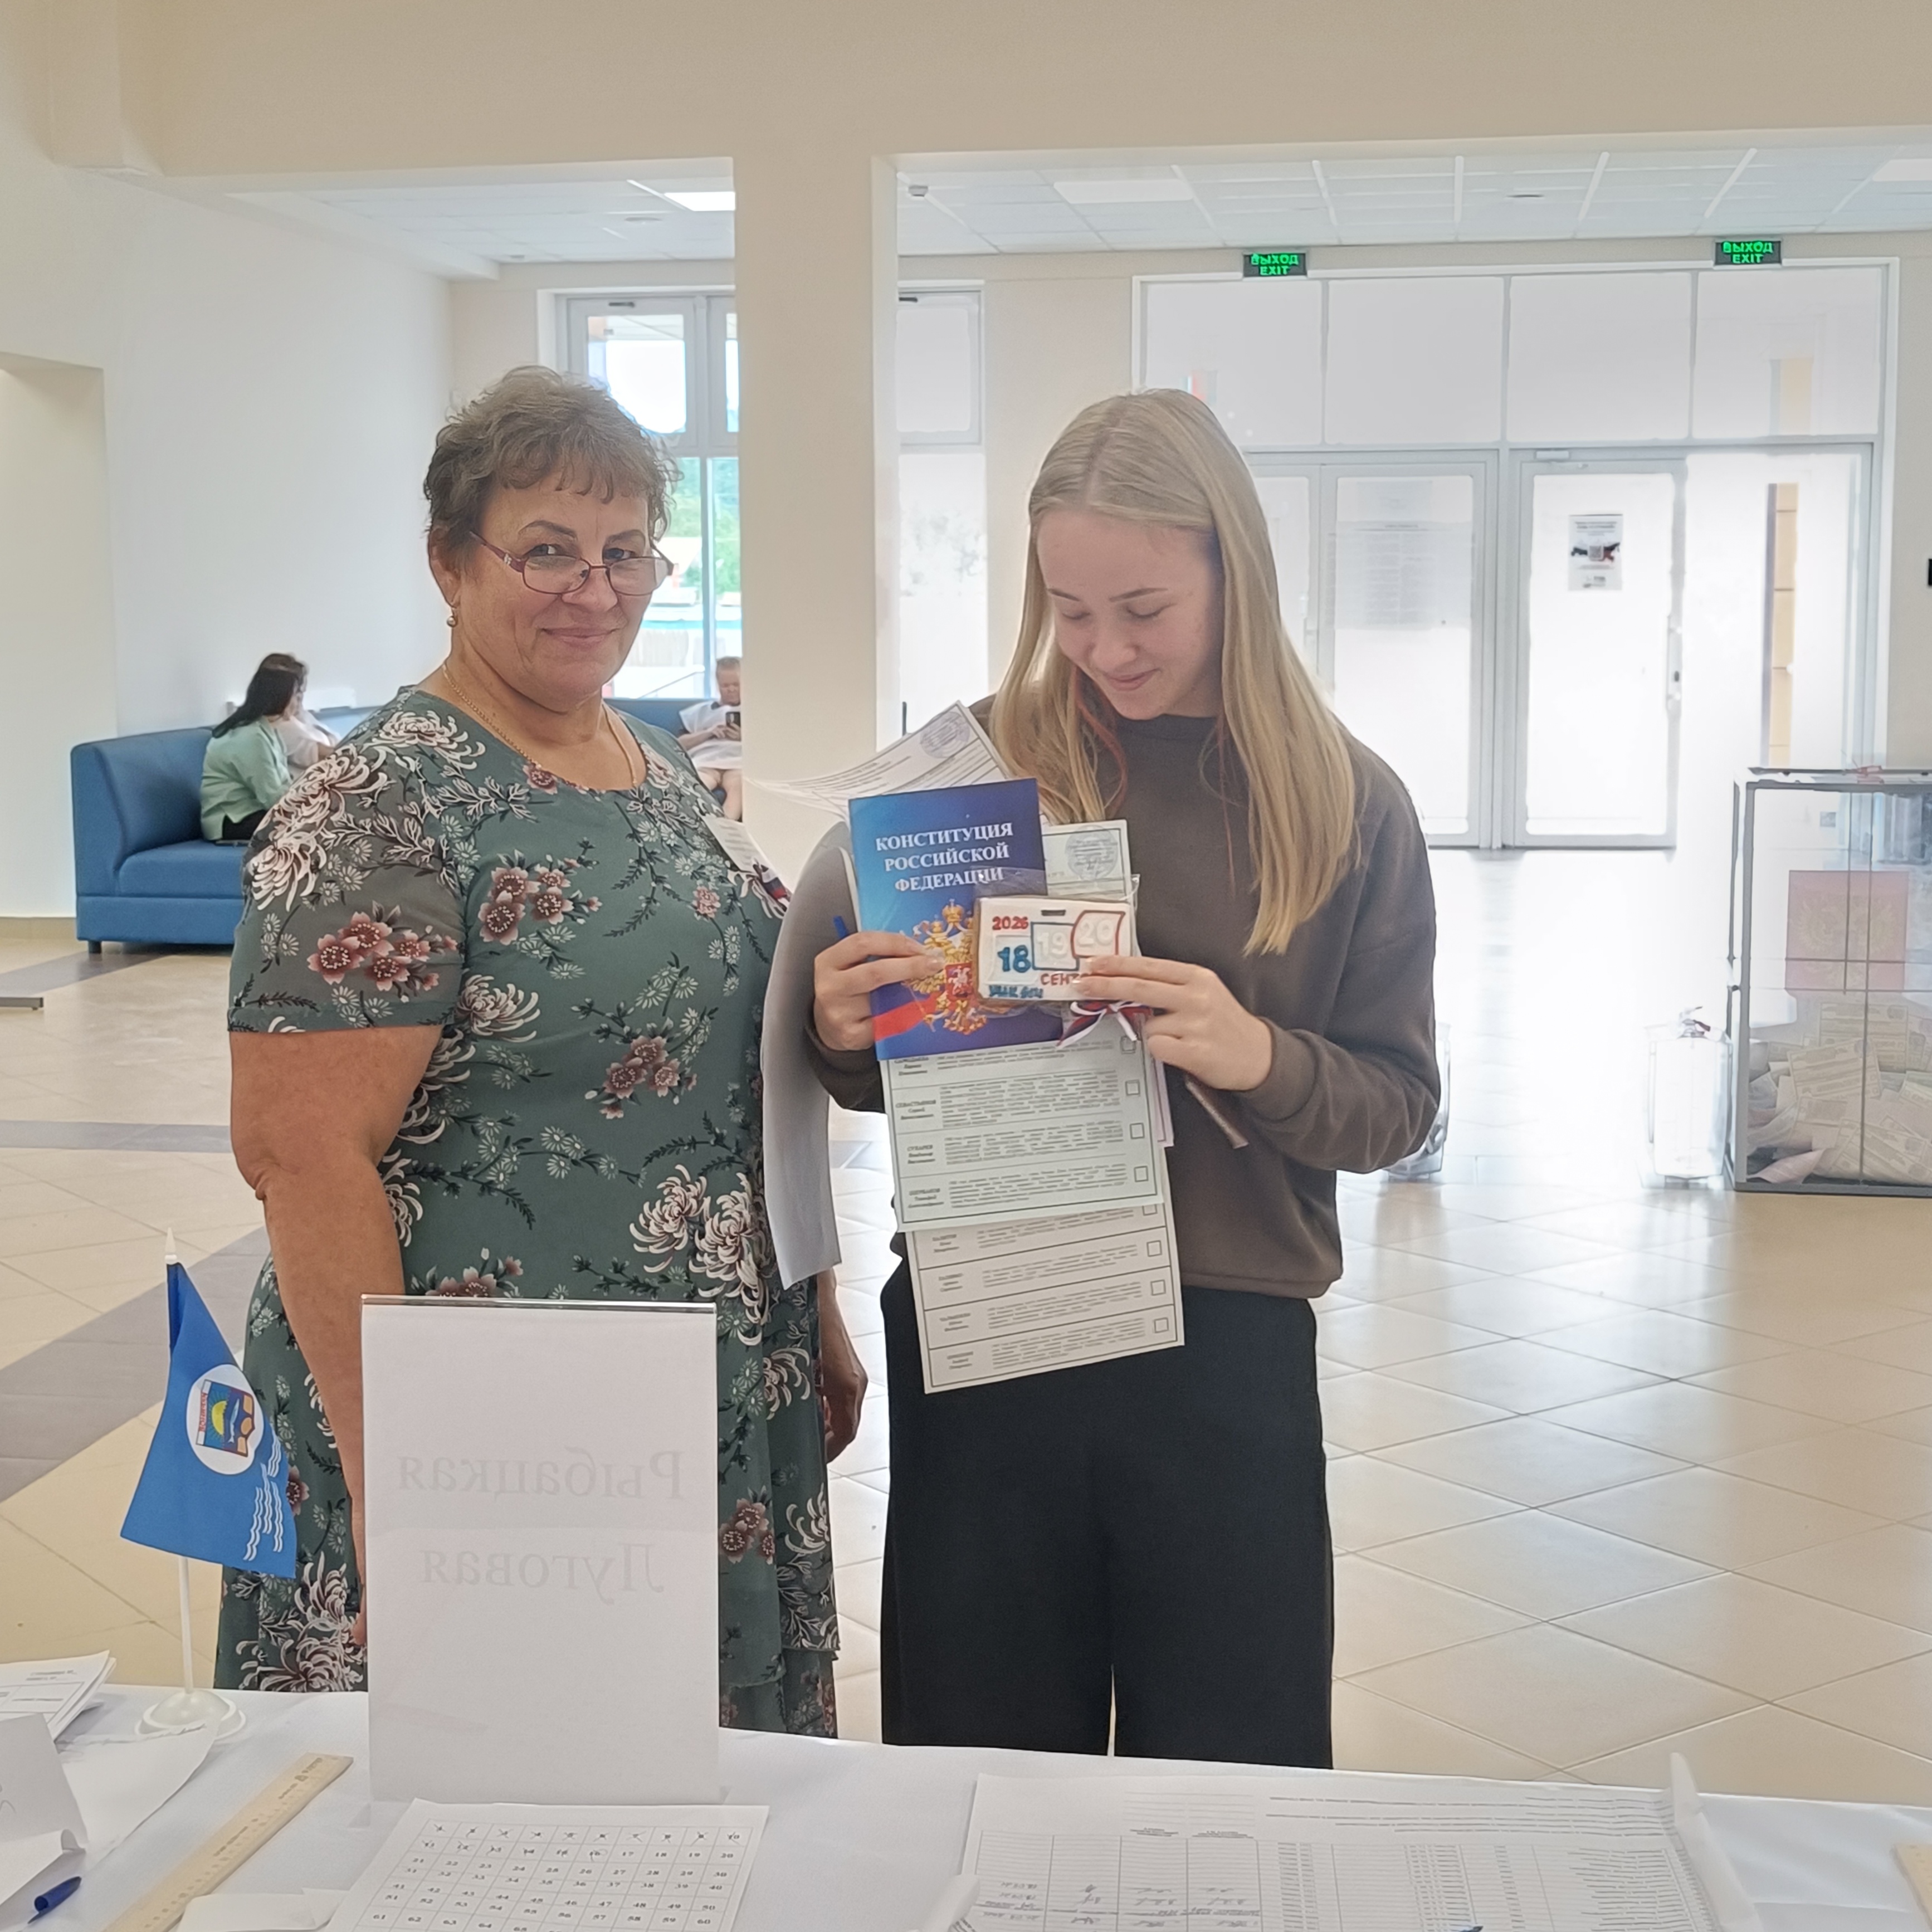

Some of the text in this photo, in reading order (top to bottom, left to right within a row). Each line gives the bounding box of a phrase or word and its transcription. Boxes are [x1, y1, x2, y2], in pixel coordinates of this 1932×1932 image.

[1723, 241, 1773, 253] ВЫХОД
[1732, 253, 1764, 264] EXIT
[1260, 266, 1290, 275] EXIT
[876, 822, 1013, 851] КОНСТИТУЦИЯ
[885, 842, 1010, 872] РОССИЙСКОЙ
[895, 867, 1005, 891] ФЕДЕРАЦИИ
[992, 916, 1029, 930] 2026
[997, 919, 1114, 973] 18 19 20
